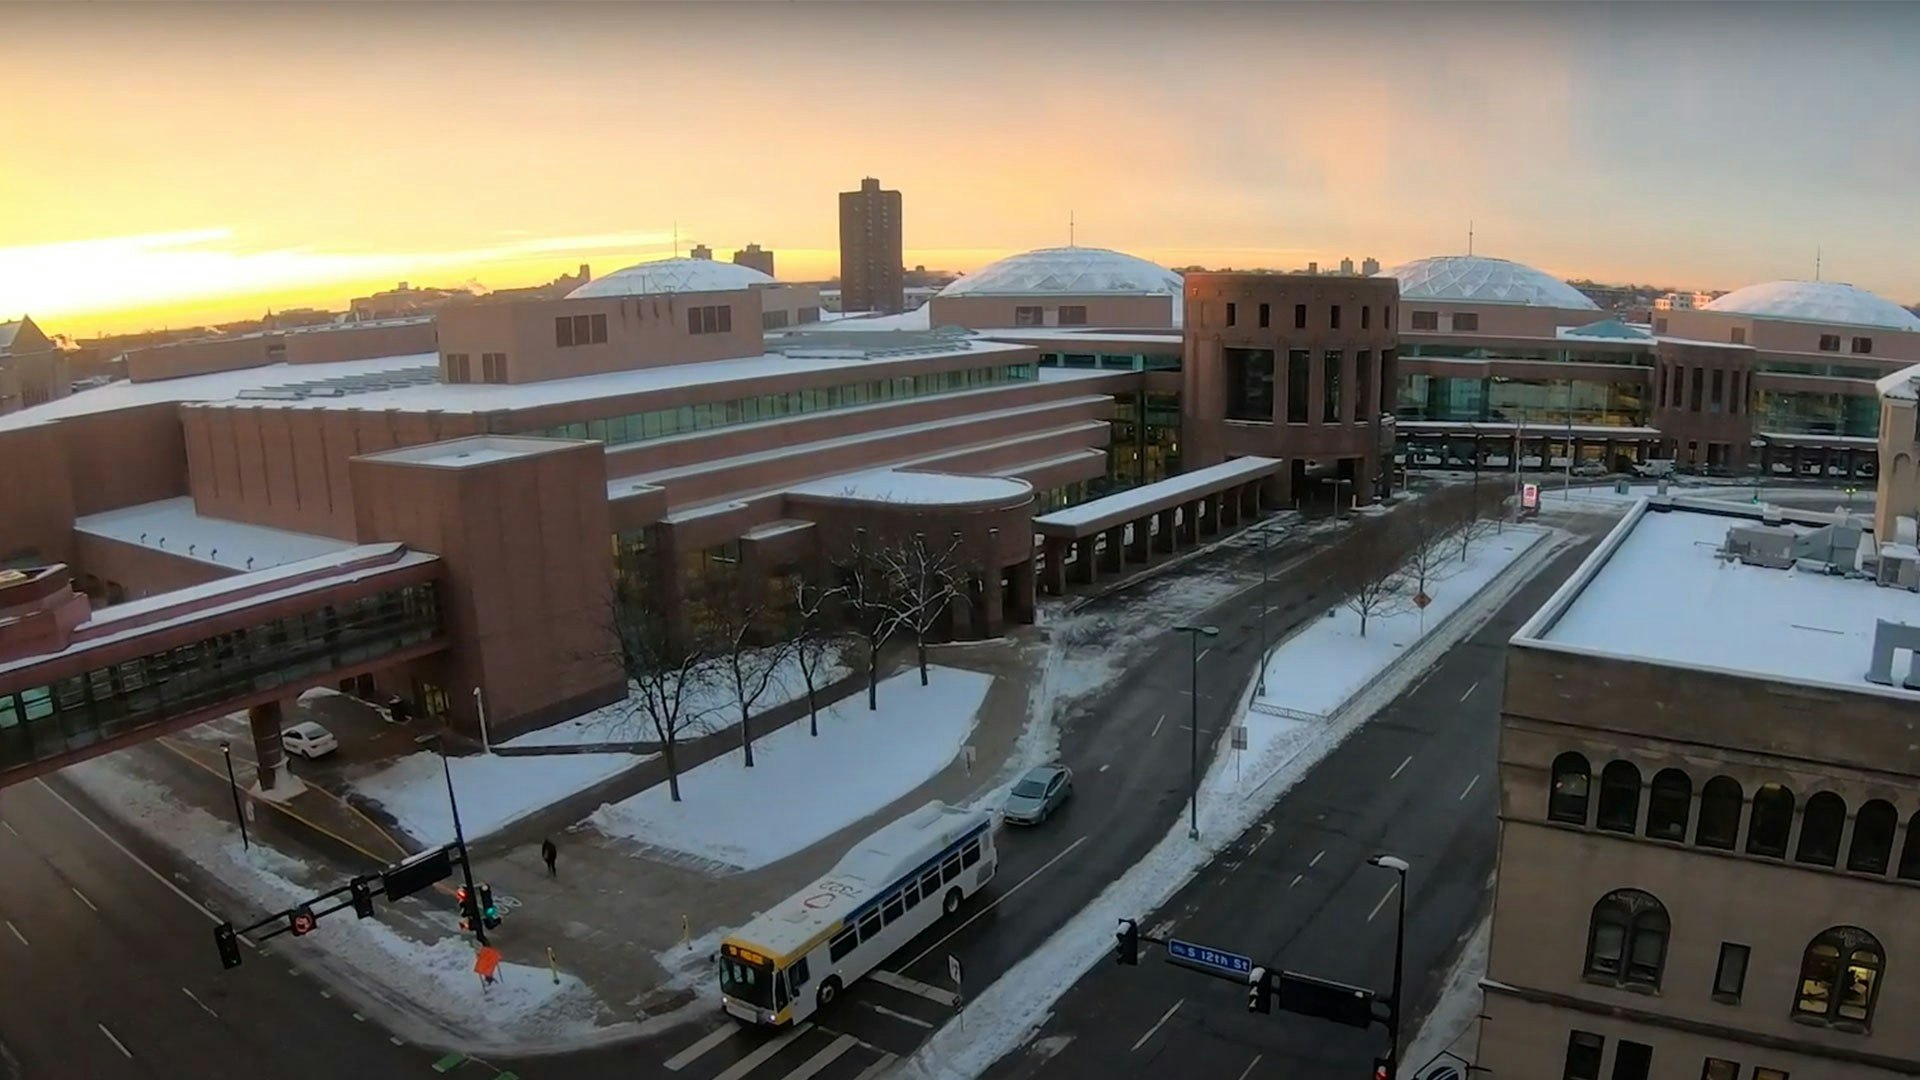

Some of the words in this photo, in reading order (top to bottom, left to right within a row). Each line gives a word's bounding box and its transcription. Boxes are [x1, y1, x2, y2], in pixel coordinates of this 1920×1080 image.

[1187, 947, 1196, 958] S
[1201, 950, 1228, 966] 12th
[1233, 958, 1248, 970] St
